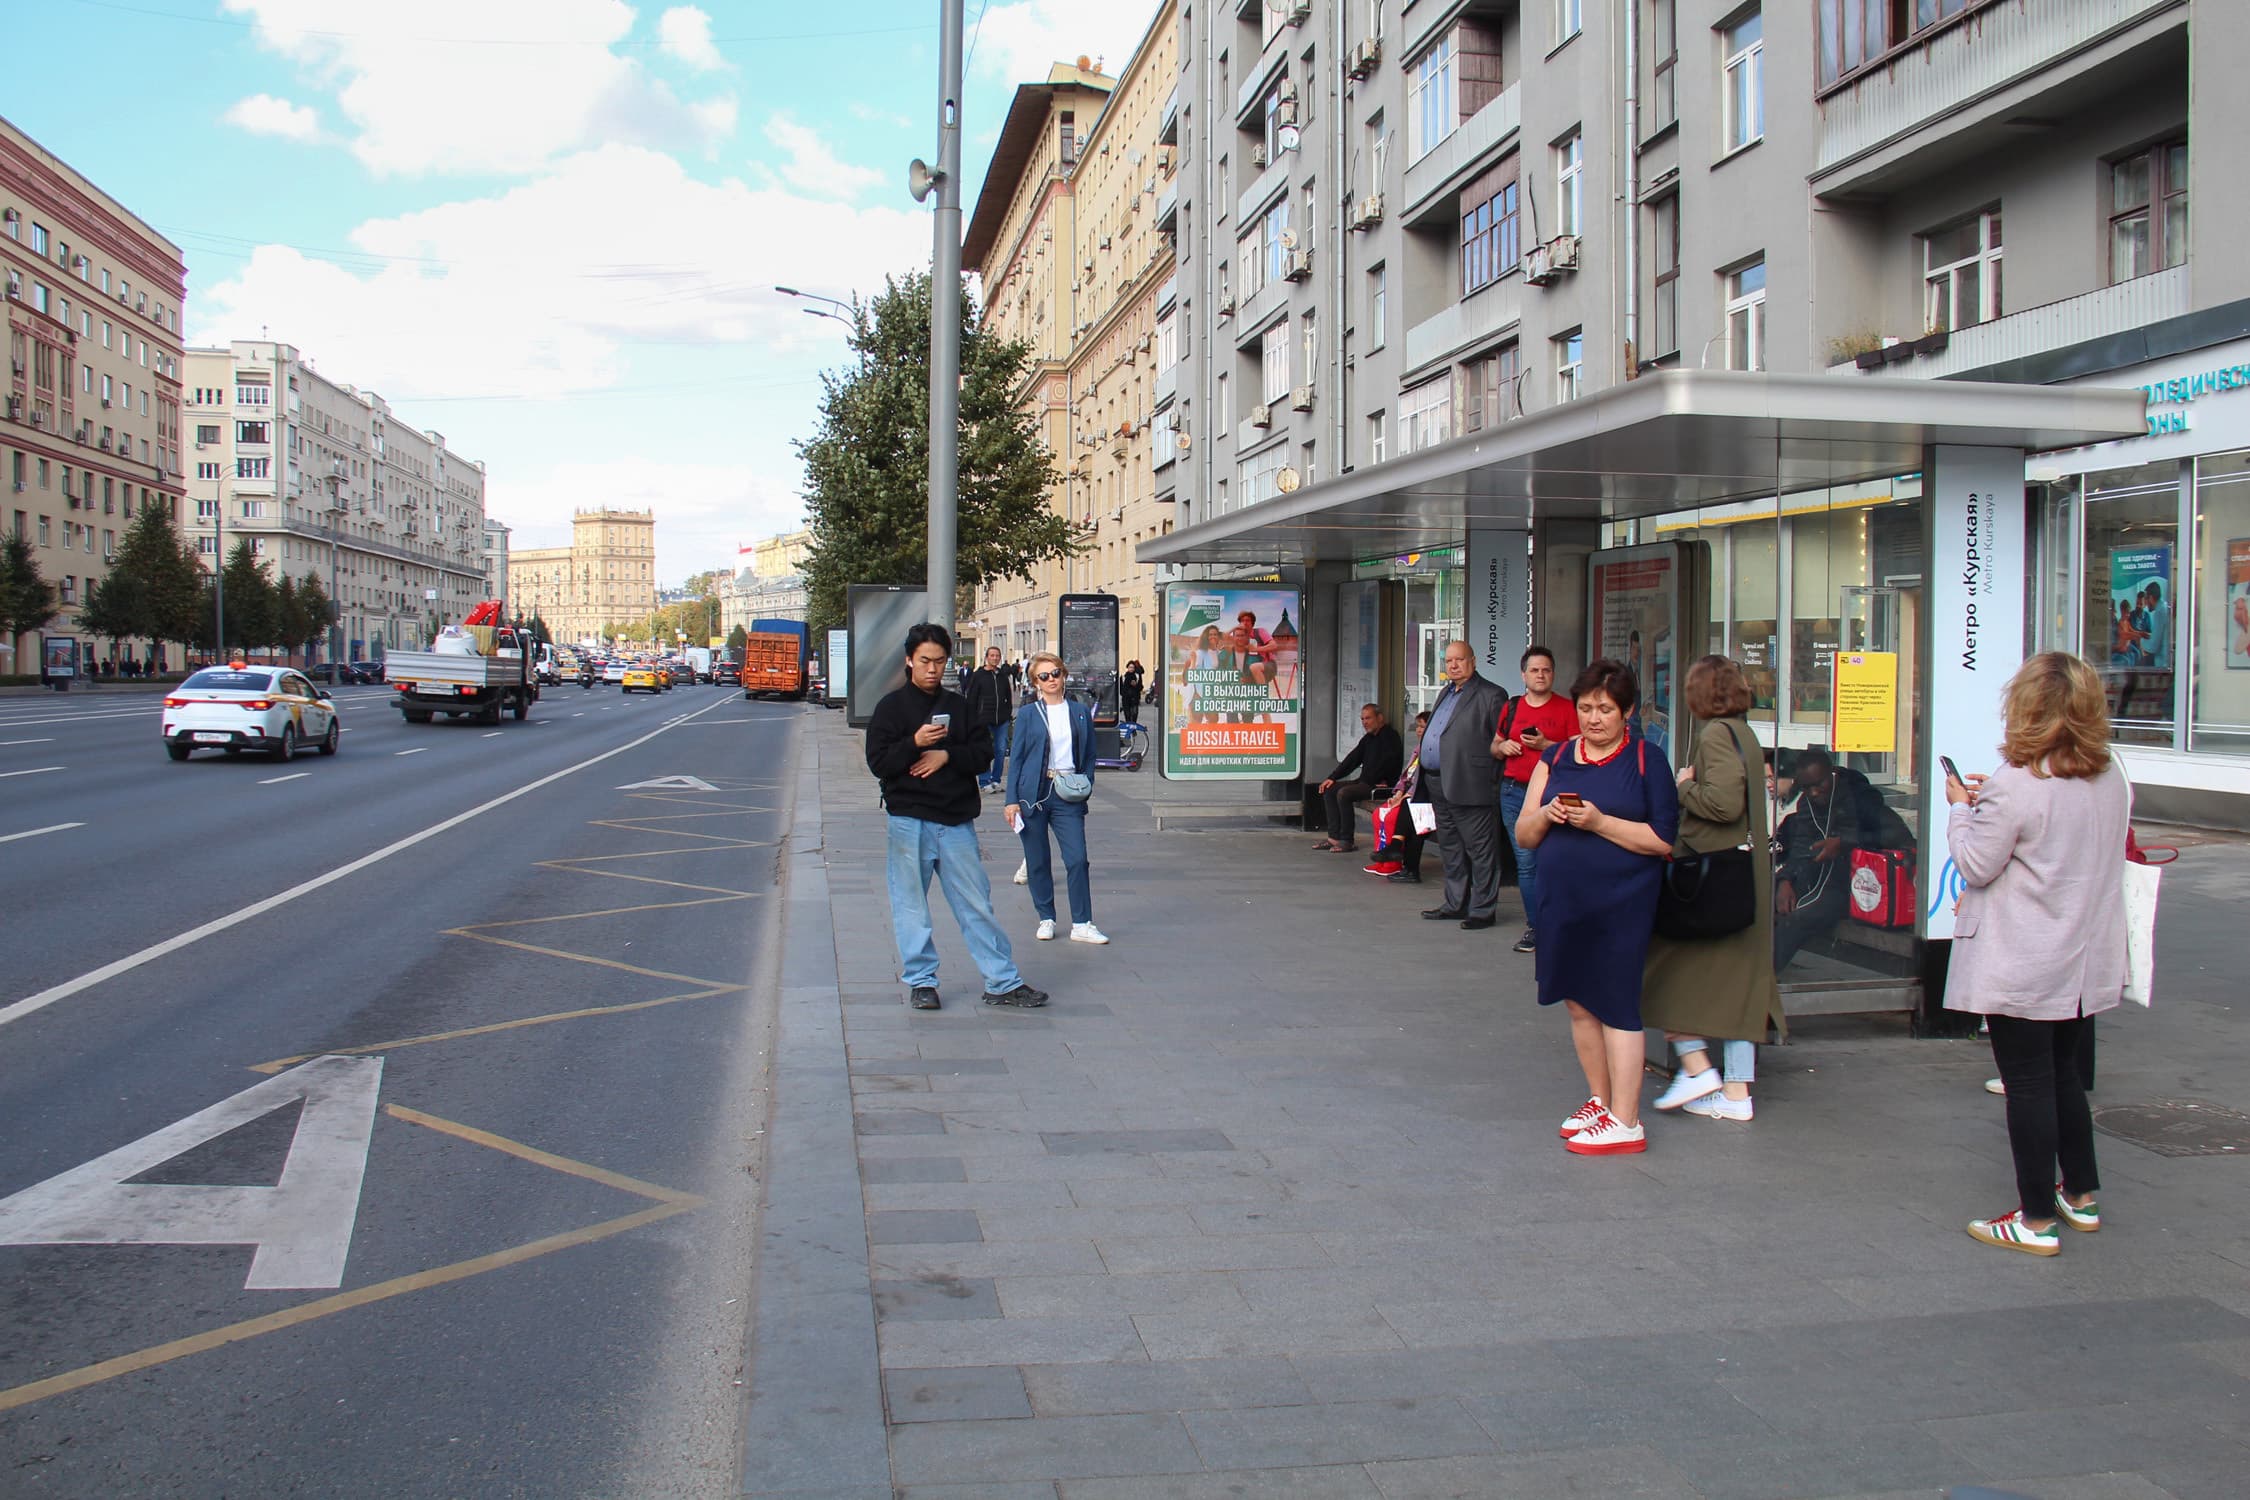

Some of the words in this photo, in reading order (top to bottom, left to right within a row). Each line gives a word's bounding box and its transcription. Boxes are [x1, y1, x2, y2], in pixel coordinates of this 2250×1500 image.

[1983, 493, 1995, 551] Kurskaya
[1962, 492, 1980, 597] «Курская»
[1487, 558, 1499, 621] «Курская»
[1983, 555, 1993, 595] Metro
[1487, 624, 1499, 666] Метро
[1962, 603, 1980, 671] Метро
[1187, 670, 1239, 682] ВЫХОДИТЕ
[1204, 685, 1211, 697] В
[1213, 685, 1268, 697] ВЫХОДНЫЕ
[1194, 701, 1201, 711] В
[1203, 700, 1251, 713] СОСЕДНИЕ
[1254, 700, 1290, 713] ГОРОДА
[1187, 730, 1279, 746] RUSSIA.TRAVEL
